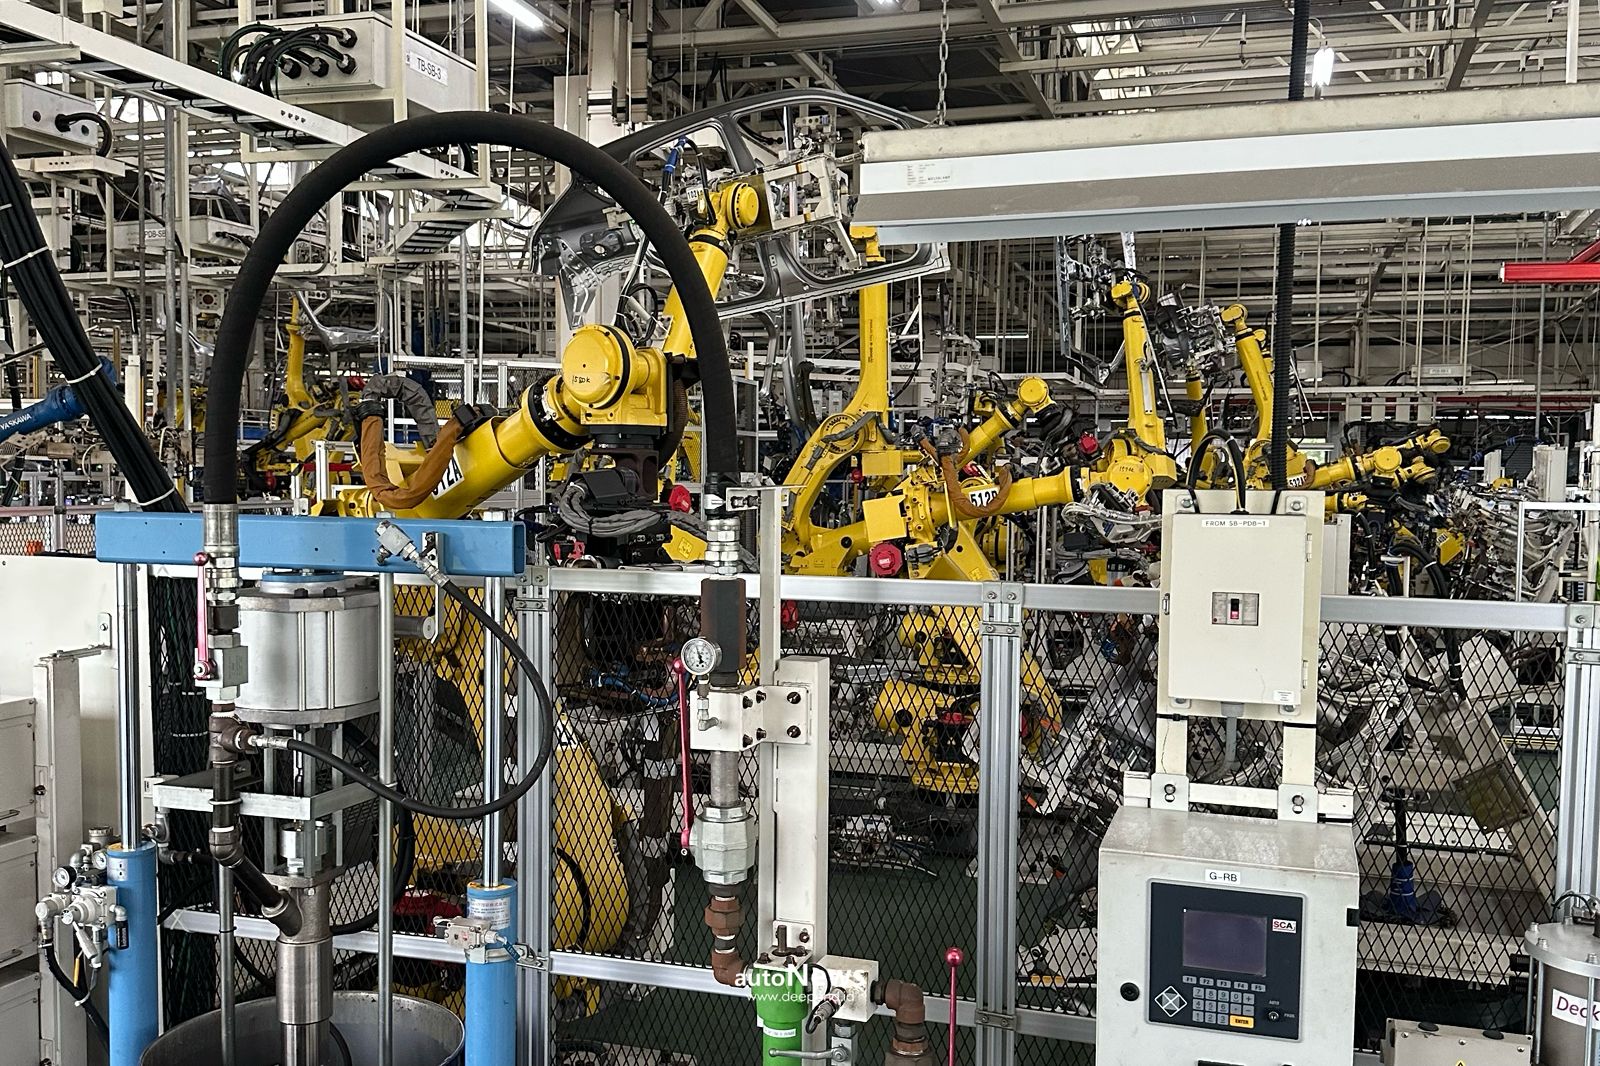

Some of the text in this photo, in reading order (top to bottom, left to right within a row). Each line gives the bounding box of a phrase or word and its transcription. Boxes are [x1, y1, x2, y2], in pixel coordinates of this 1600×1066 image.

[417, 57, 442, 80] TB-SB-3
[0, 413, 32, 430] YASKAWA
[431, 456, 463, 496] 2A
[1209, 871, 1238, 882] G-RB
[1273, 921, 1293, 930] SCA
